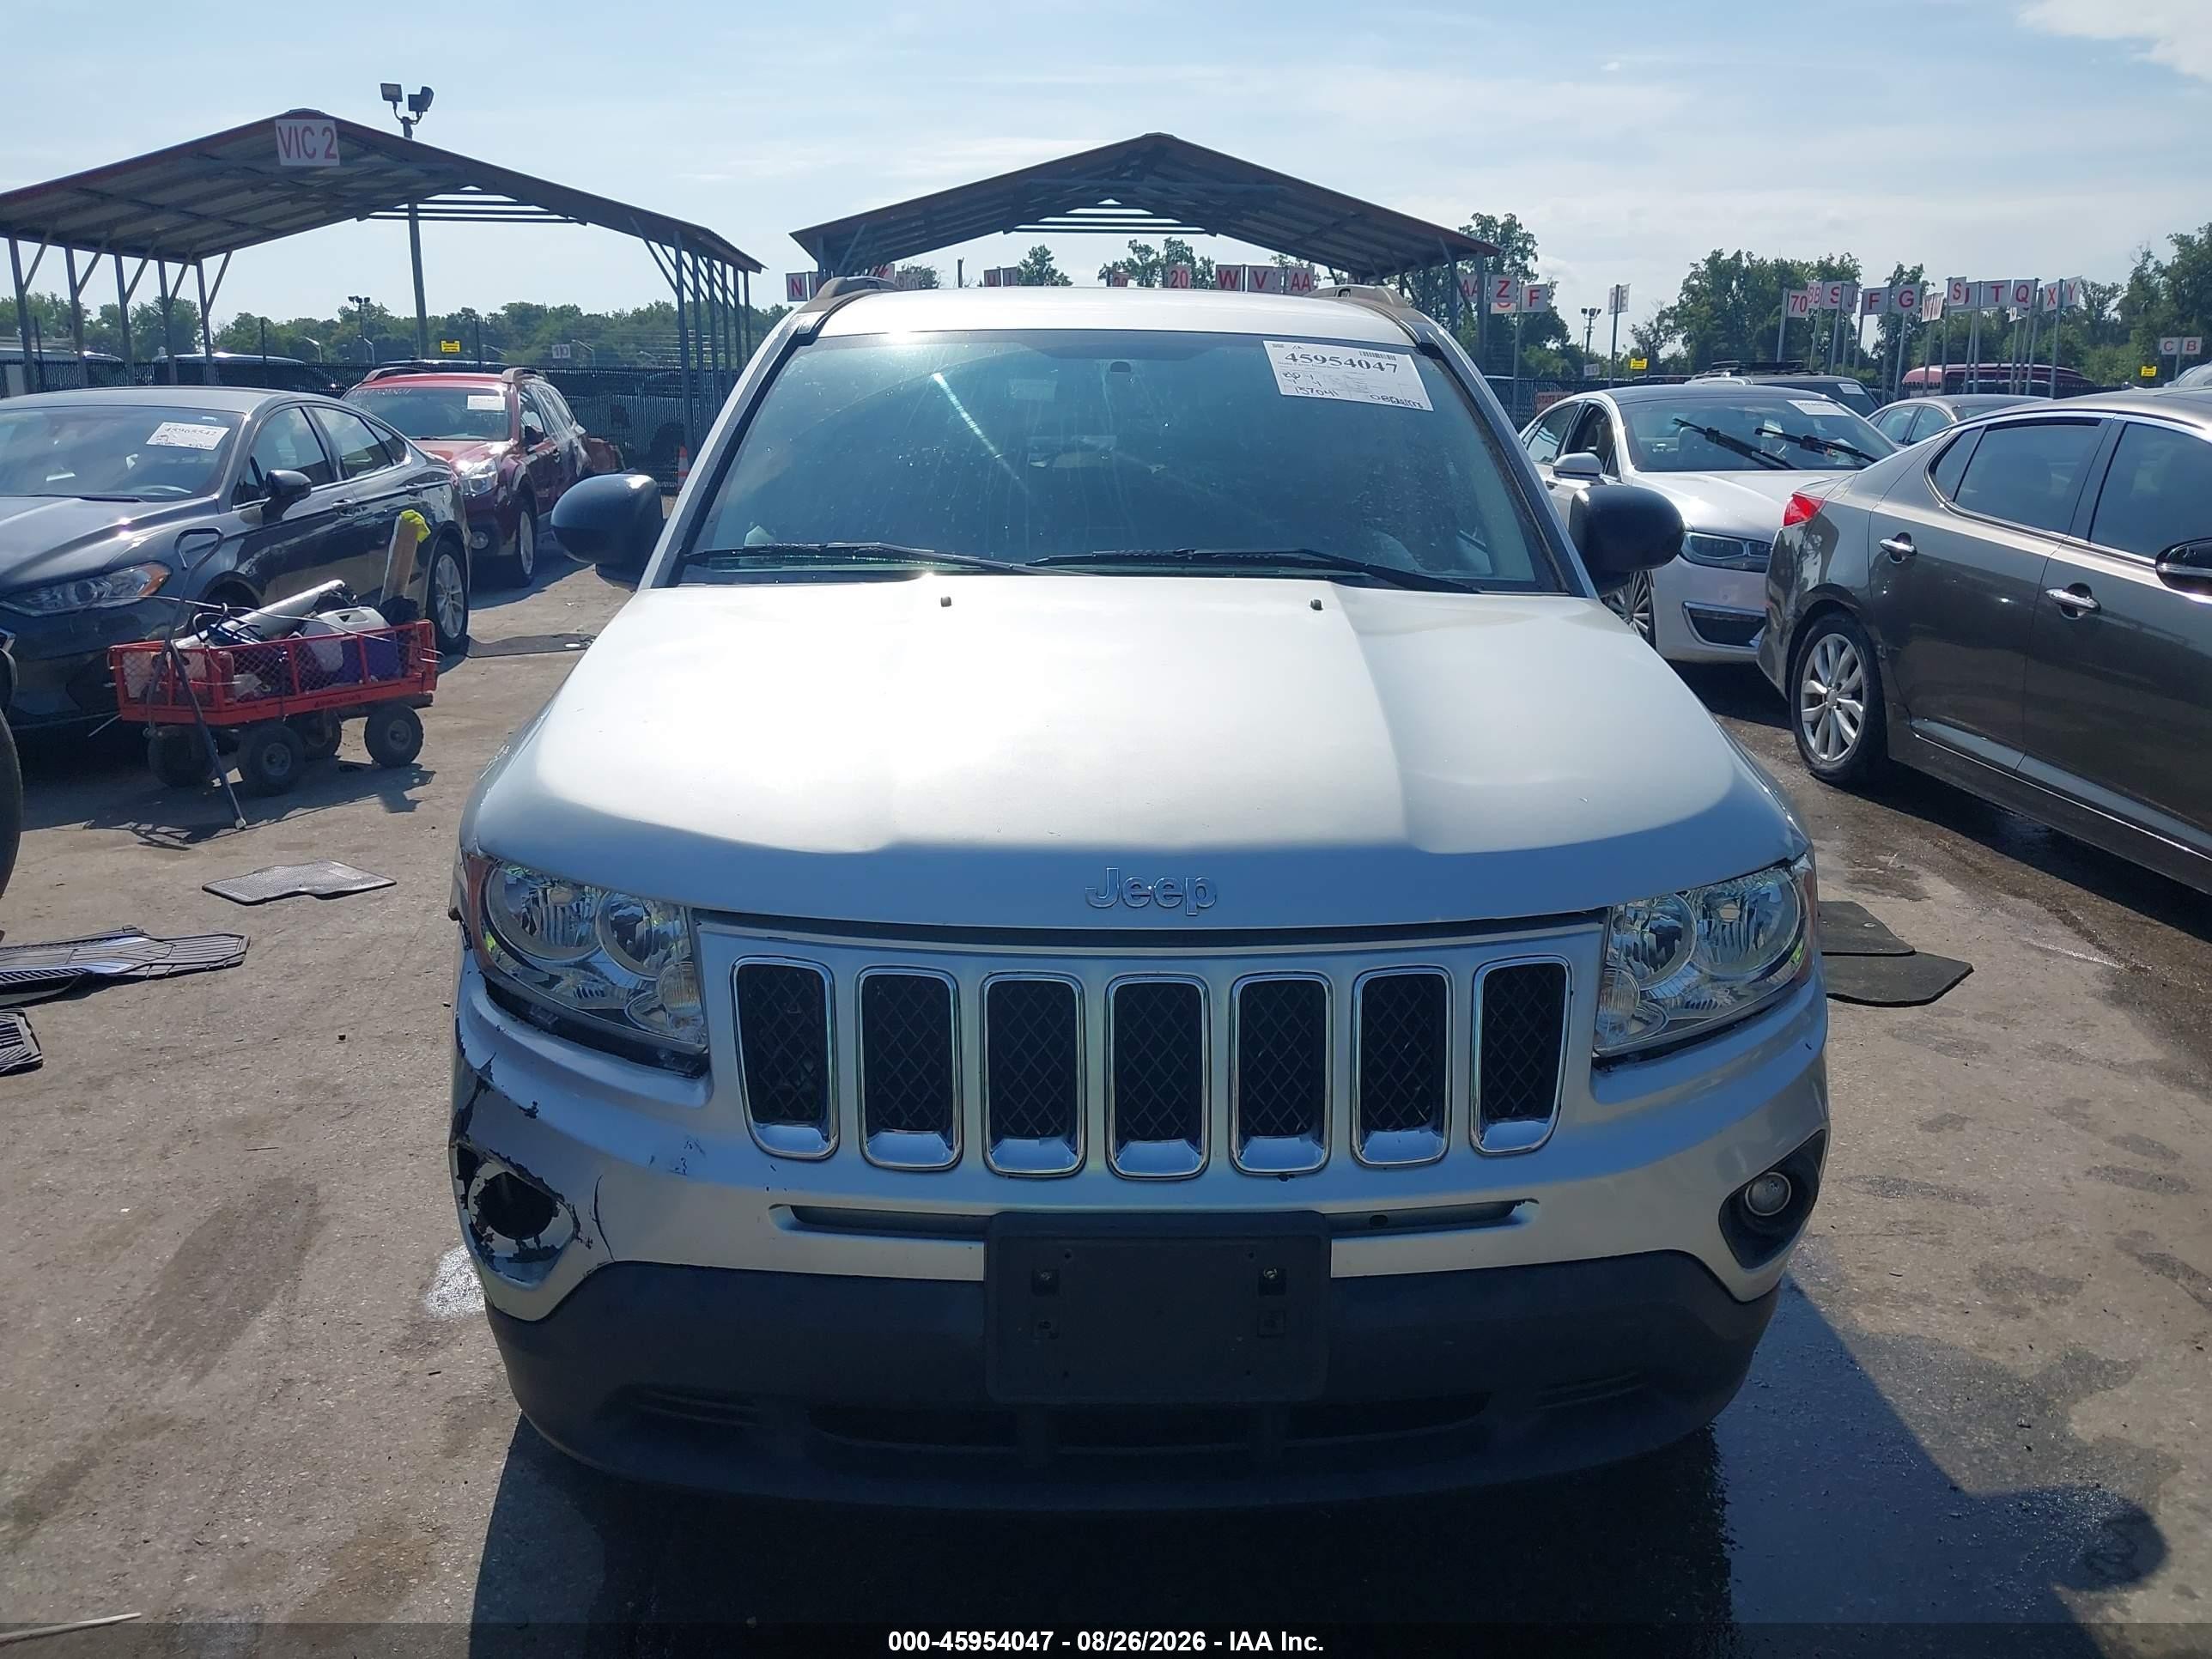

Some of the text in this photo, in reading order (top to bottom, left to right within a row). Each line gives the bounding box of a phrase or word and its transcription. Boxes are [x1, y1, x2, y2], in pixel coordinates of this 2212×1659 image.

[278, 125, 337, 159] VIC 2
[791, 278, 802, 296] N
[1170, 270, 1188, 289] 20
[1218, 270, 1239, 289] W
[1254, 271, 1267, 289] V
[1291, 276, 1311, 292] AA
[1496, 280, 1510, 298] Z
[1528, 289, 1540, 307] F
[1830, 287, 1840, 303] S
[1953, 283, 1961, 300] S
[1991, 285, 2005, 302] T
[2015, 284, 2029, 303] Q
[2046, 288, 2057, 306] X
[2068, 282, 2078, 301] Y
[1791, 295, 1808, 313] 70
[1869, 293, 1881, 309] F
[1899, 290, 1914, 307] G
[2164, 341, 2173, 351] C
[2186, 341, 2197, 351] B
[1285, 352, 1398, 373] 45954047
[1085, 867, 1217, 916] Jeep
